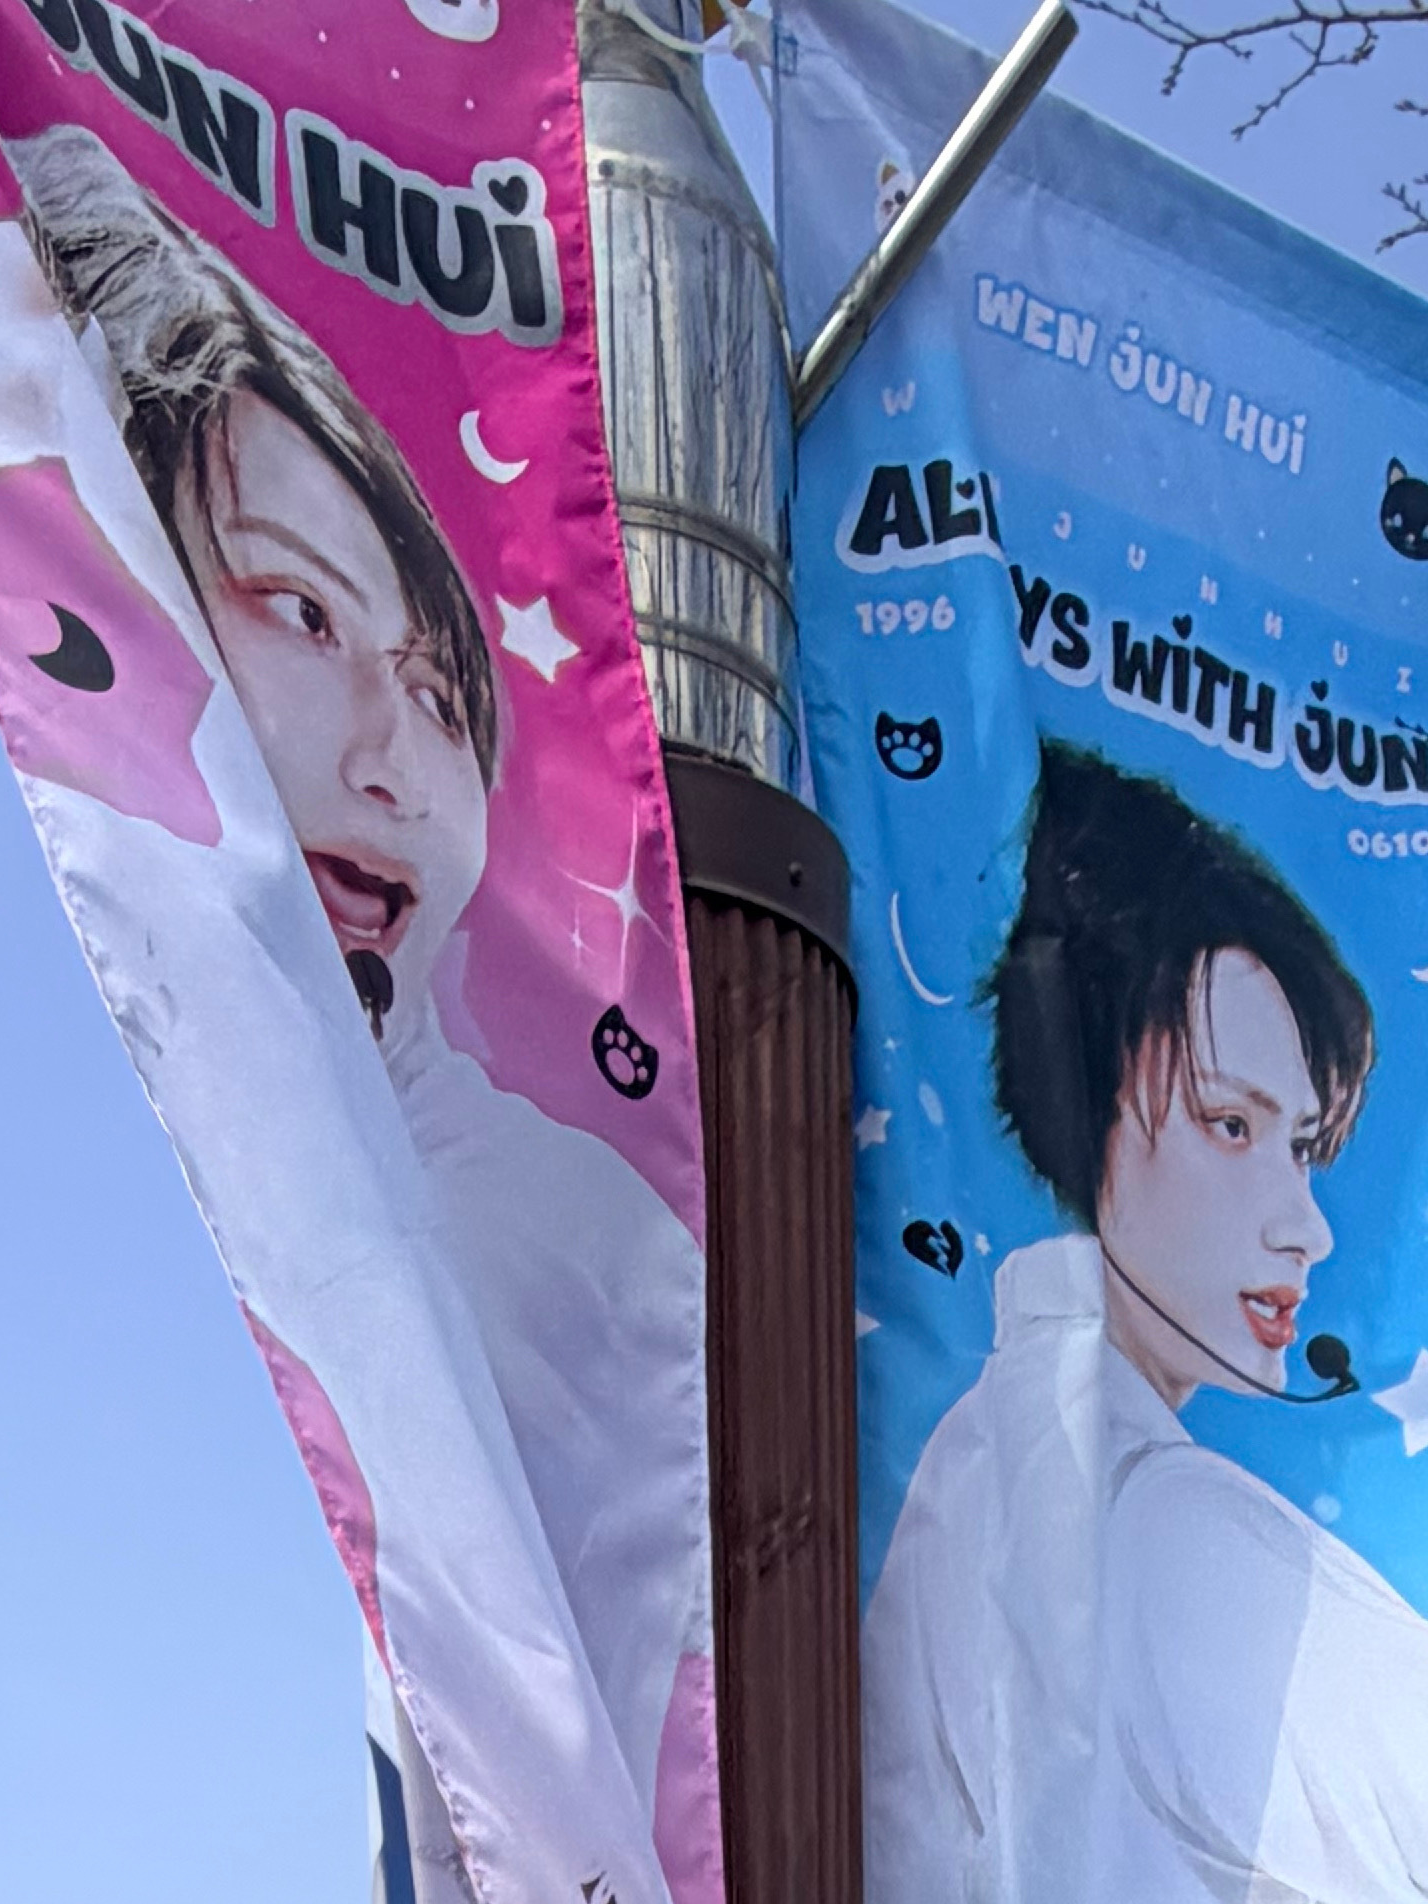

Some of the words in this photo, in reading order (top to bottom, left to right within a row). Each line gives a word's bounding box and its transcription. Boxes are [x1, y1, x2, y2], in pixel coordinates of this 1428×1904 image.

[978, 278, 1097, 367] WEN
[849, 459, 1090, 669] ALYS
[855, 595, 956, 635] 1996
